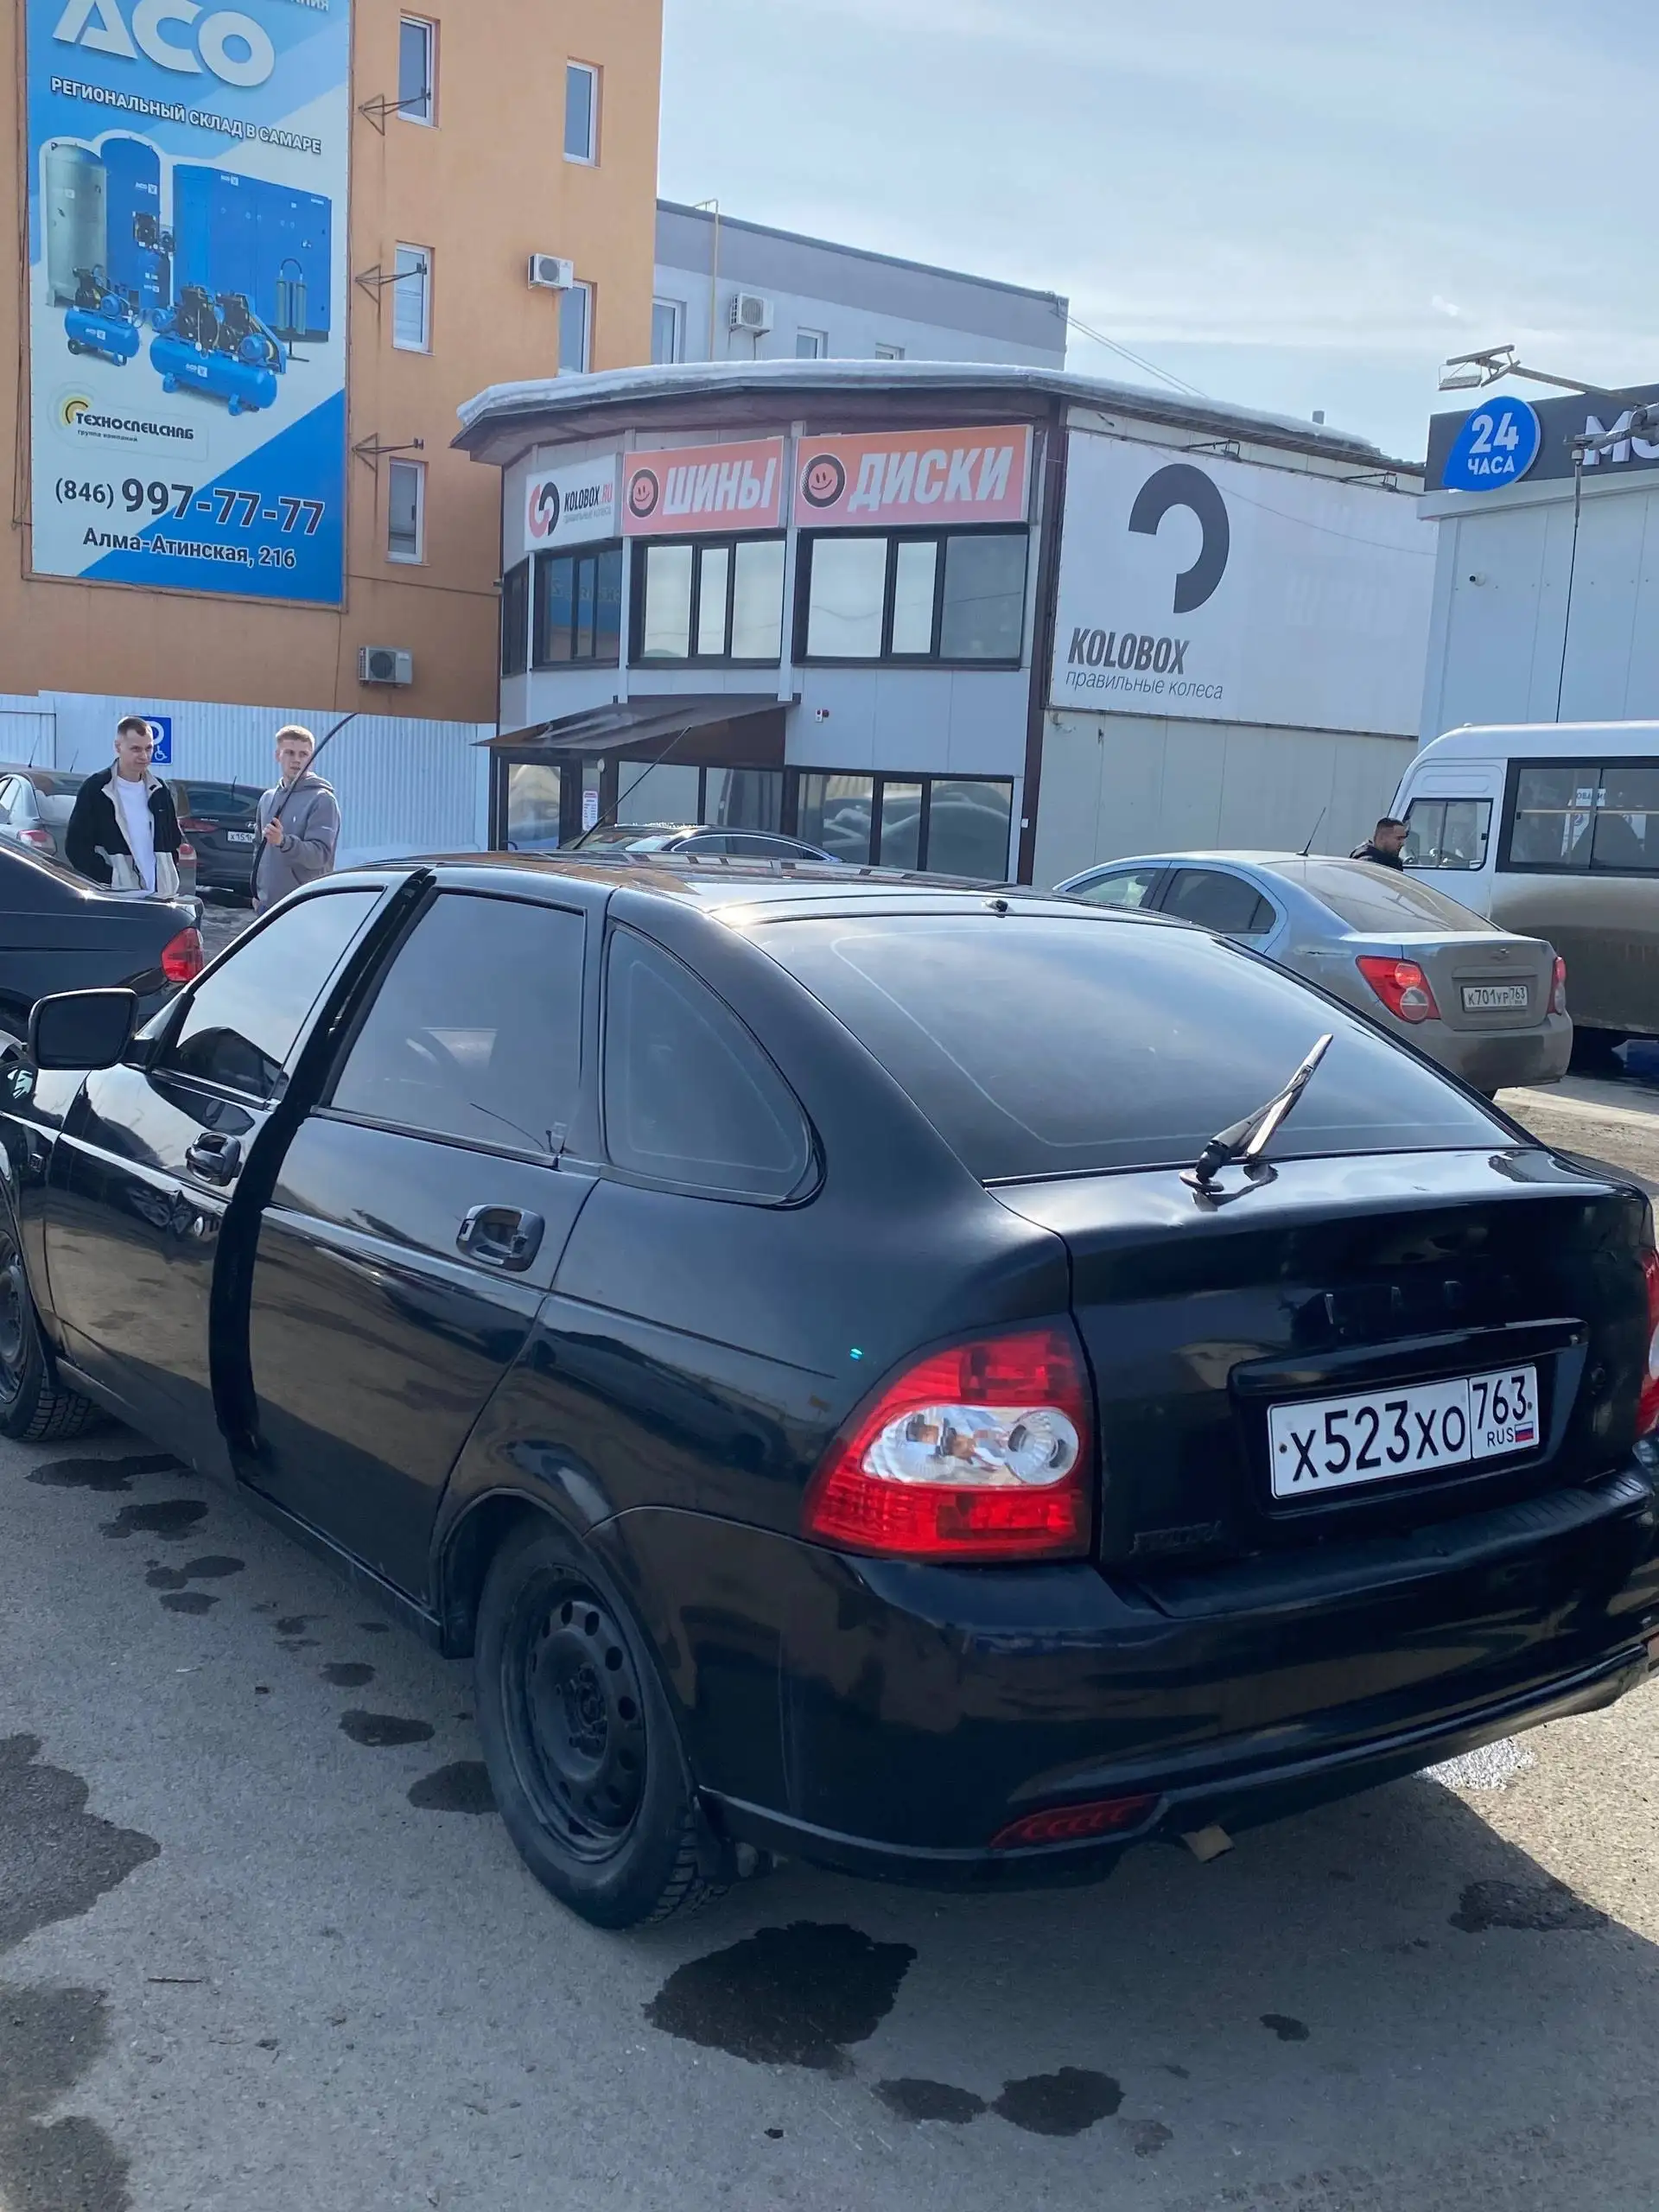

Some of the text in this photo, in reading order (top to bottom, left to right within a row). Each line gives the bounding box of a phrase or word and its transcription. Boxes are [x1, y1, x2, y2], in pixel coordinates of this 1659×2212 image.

[50, 77, 322, 155] РЕГИОНАЛЬНЫЙ СКЛАД В САМАРЕ
[1469, 413, 1519, 454] 24
[1582, 410, 1659, 465] М
[662, 457, 777, 515] ШИНЫ
[848, 447, 1014, 512] ДИСКИ
[1467, 456, 1515, 475] ЧАСА
[55, 477, 325, 536] (846) 997-77-77
[83, 527, 296, 569] Алма-Атинская, 216
[1068, 627, 1191, 675] KOLOBOX
[1065, 671, 1224, 699] правильные колеса
[1510, 987, 1525, 1000] 763
[1290, 1376, 1527, 1483] Х523ХО 763
[1486, 1428, 1515, 1448] RUS
